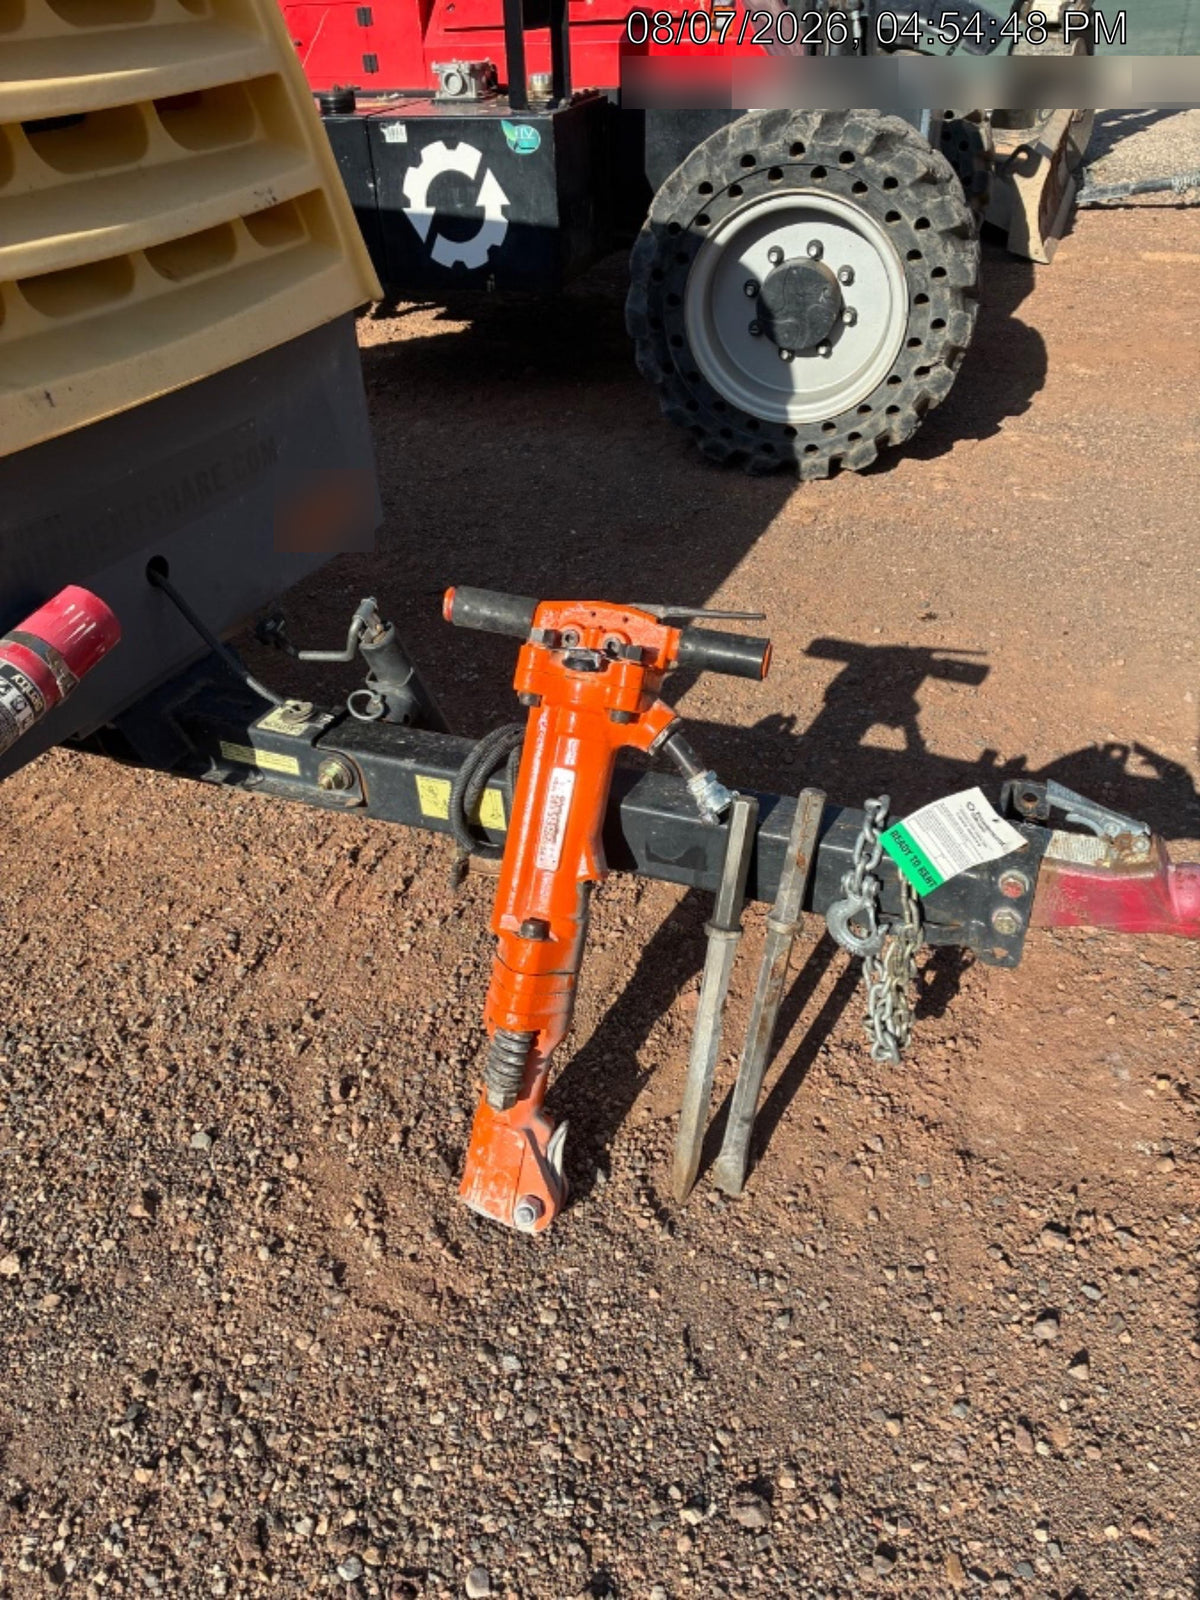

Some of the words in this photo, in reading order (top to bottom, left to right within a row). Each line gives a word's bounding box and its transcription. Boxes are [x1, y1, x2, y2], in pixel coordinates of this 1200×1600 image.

[890, 830, 914, 856] READY
[909, 855, 922, 868] TO
[917, 866, 938, 888] RENT
